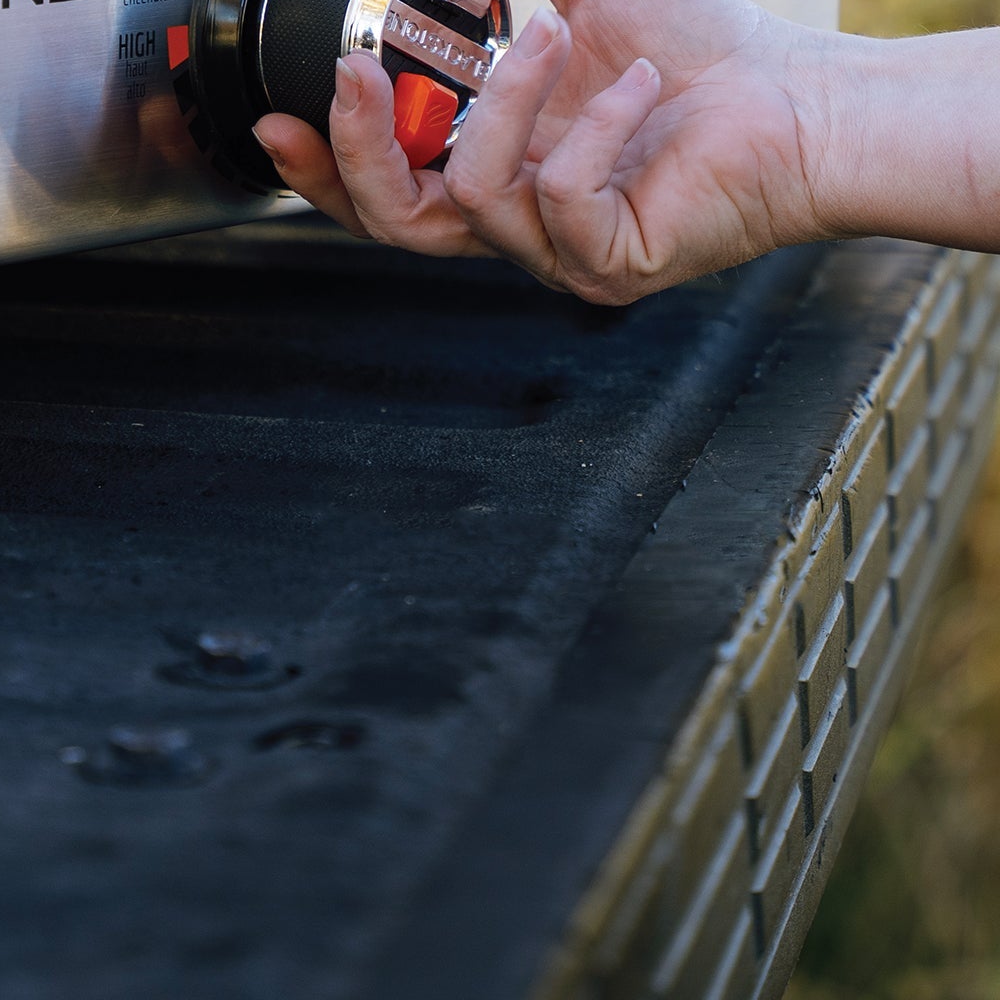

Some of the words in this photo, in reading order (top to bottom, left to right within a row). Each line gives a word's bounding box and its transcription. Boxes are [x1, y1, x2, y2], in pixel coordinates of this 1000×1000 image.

[119, 30, 156, 60] HIGH
[126, 60, 148, 78] haut
[127, 81, 146, 99] alto
